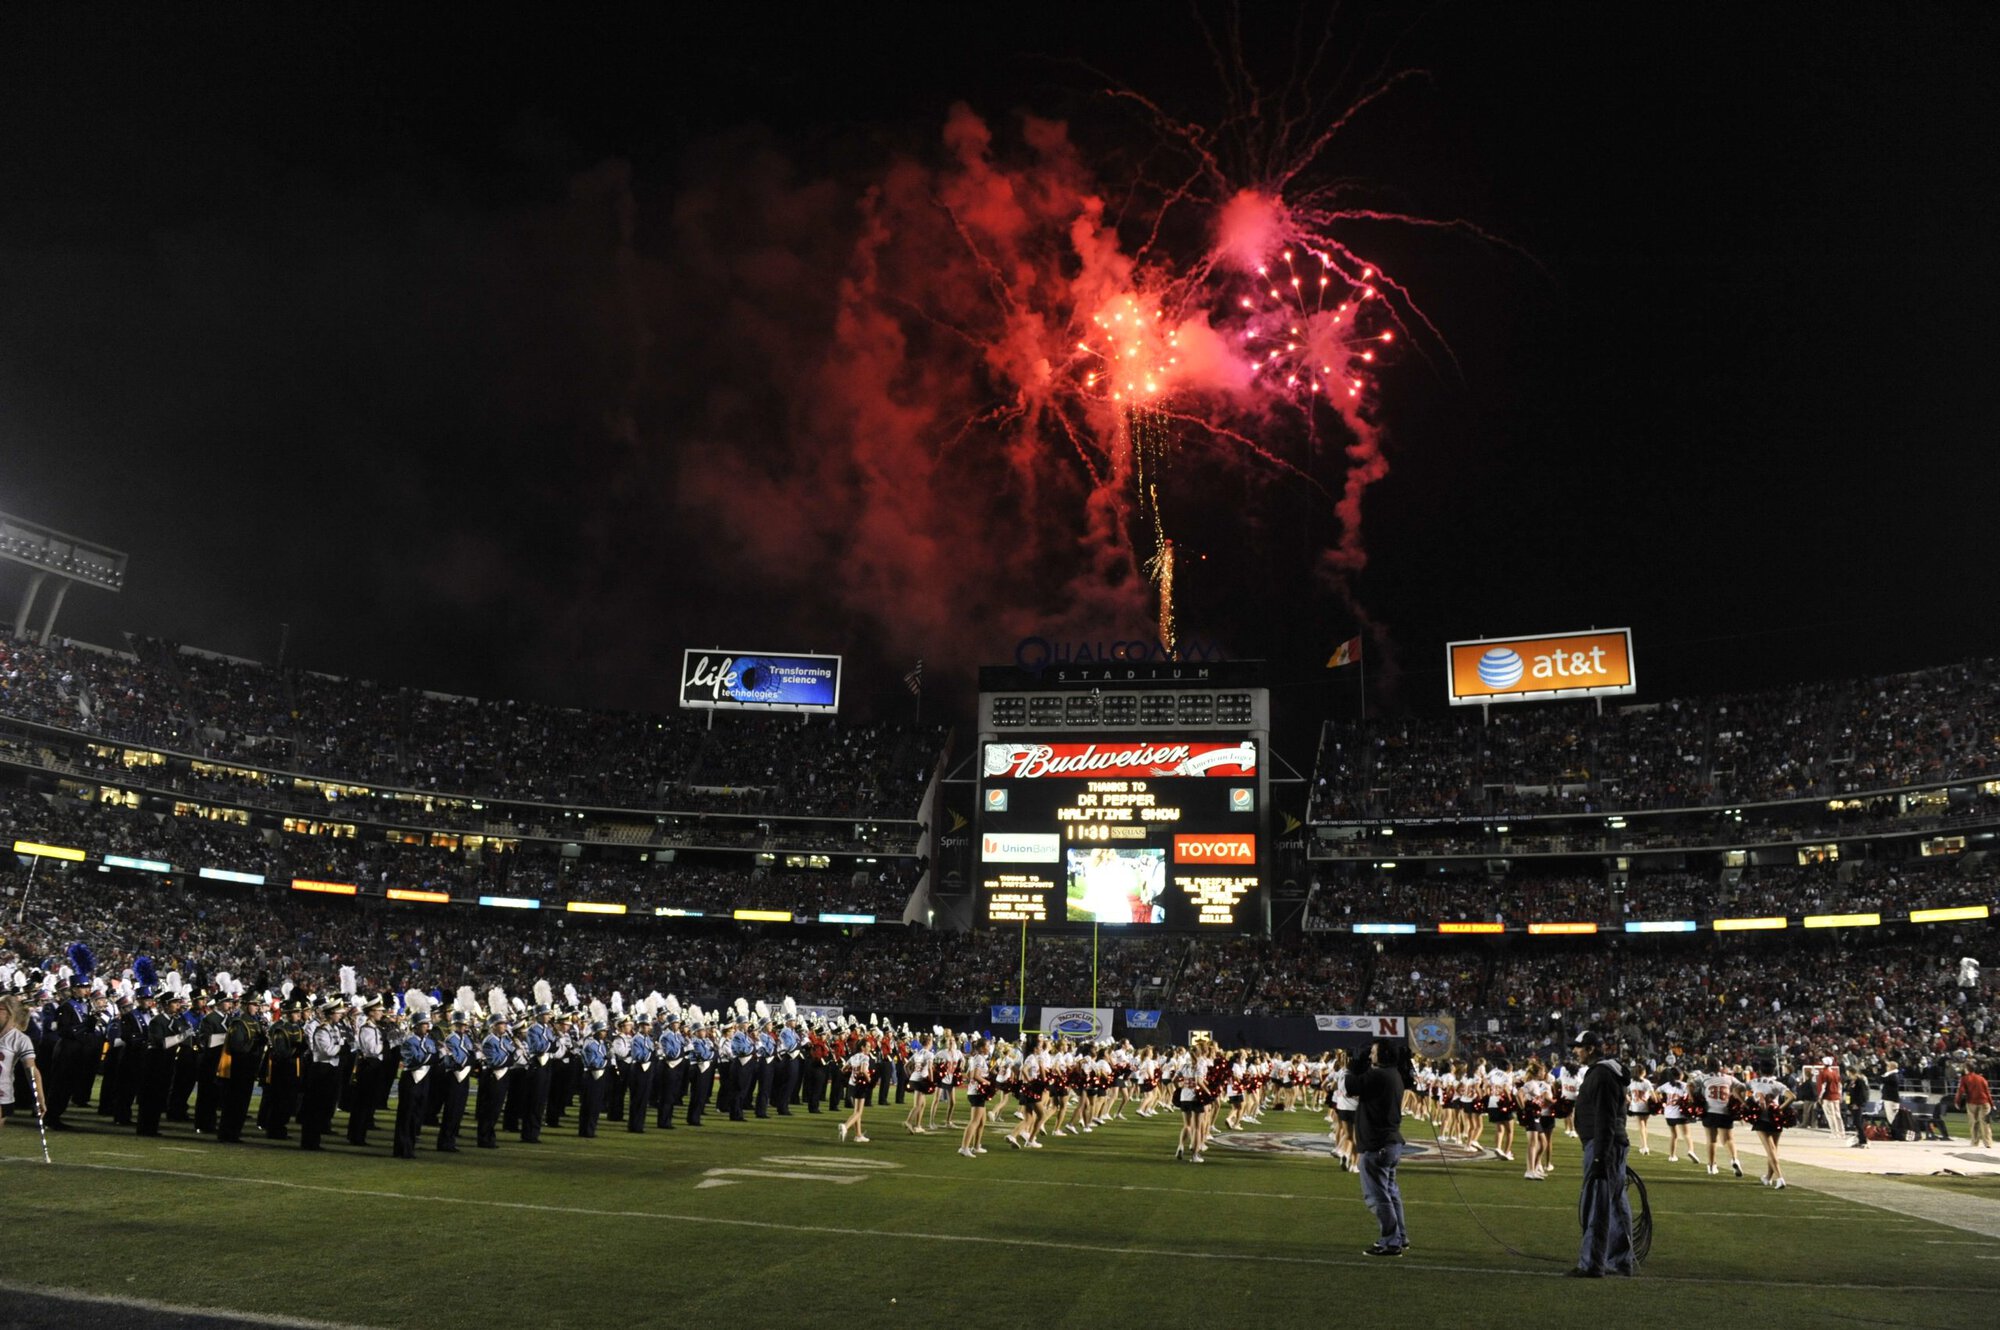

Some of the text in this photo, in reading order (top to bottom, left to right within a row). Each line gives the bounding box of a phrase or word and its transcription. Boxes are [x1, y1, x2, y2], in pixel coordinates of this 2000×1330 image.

[1532, 646, 1607, 679] at&t
[686, 656, 738, 699] life
[769, 666, 831, 678] Transforming
[1058, 669, 1209, 680] STADIUM
[782, 676, 817, 684] science
[1008, 743, 1189, 778] Budweiser
[1088, 782, 1147, 792] THANKS TO
[1078, 794, 1155, 806] DR PEPPER
[1058, 808, 1181, 820] HALFTIME SHOW
[940, 836, 969, 848] Sprint
[1274, 839, 1304, 850] Sprint
[1002, 844, 1057, 853] UnionBank
[1178, 843, 1251, 857] TOYOTA
[1440, 924, 1503, 933] WELLS FARGO
[1057, 1013, 1081, 1022] PACIFIC
[1379, 1018, 1398, 1035] N
[1191, 1031, 1210, 1046] 25
